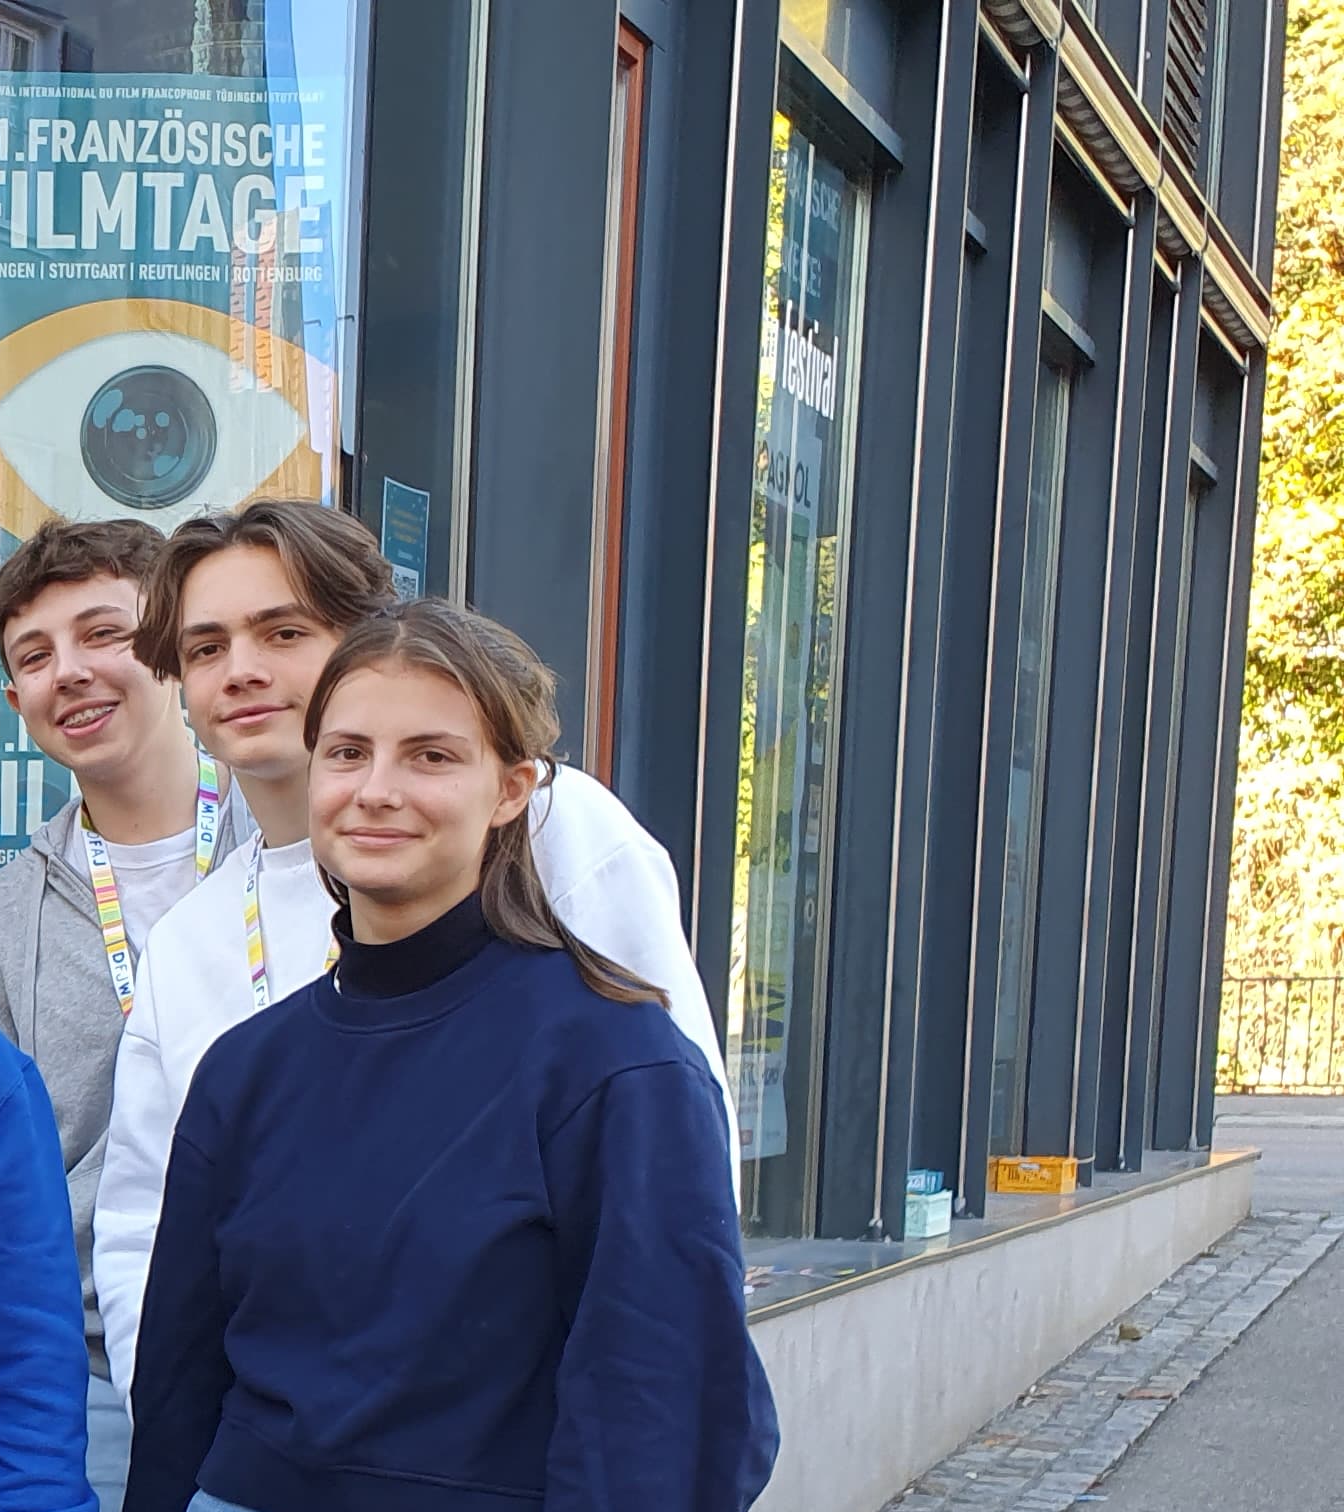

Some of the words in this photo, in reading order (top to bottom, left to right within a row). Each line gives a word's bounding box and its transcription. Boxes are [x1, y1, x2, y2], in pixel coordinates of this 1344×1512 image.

[19, 85, 96, 100] INTERNATIONAL
[99, 88, 113, 100] DU
[115, 88, 139, 100] FILM
[49, 261, 125, 281] STUTTGART
[138, 262, 220, 282] REUTLINGEN
[232, 264, 322, 283] ROTTENBURG
[781, 299, 839, 422] festival
[201, 802, 215, 843] DFJW
[112, 952, 132, 996] DFJW
